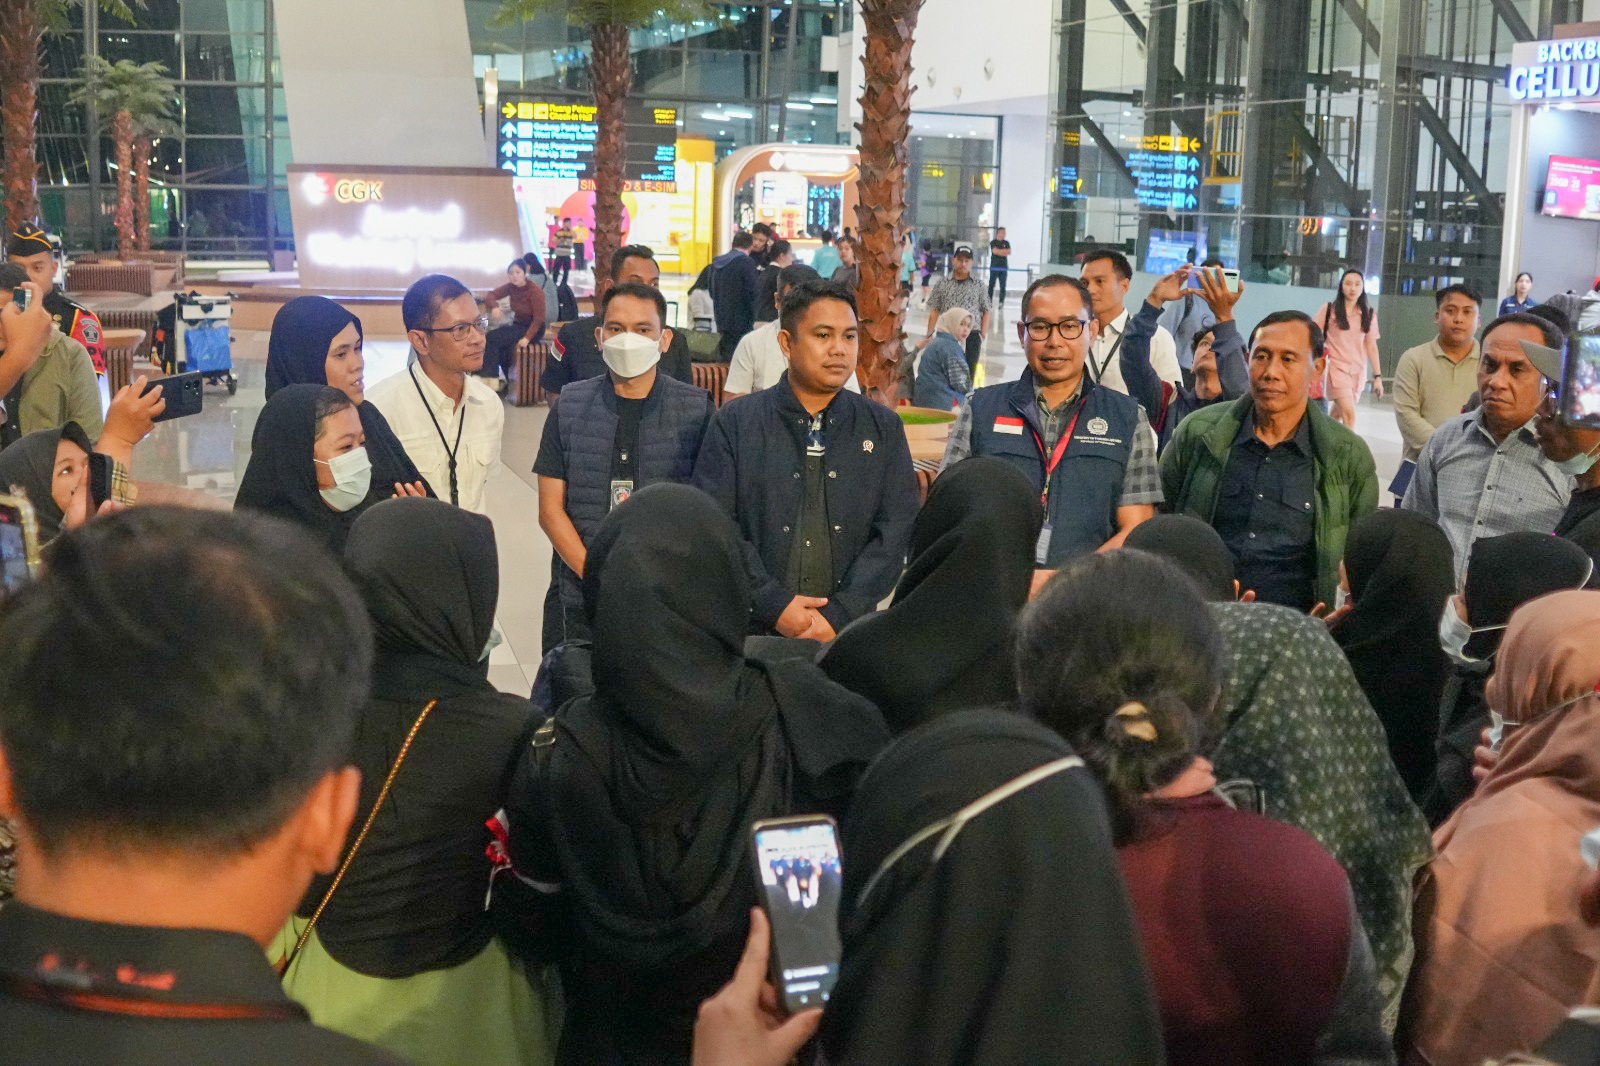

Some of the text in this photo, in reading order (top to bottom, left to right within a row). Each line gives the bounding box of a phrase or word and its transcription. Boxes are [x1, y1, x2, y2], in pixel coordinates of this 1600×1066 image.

[1537, 40, 1600, 63] BACKB
[1509, 62, 1600, 100] CELLU
[336, 180, 383, 202] CGK
[634, 182, 642, 192] &
[644, 181, 676, 192] E-SIM
